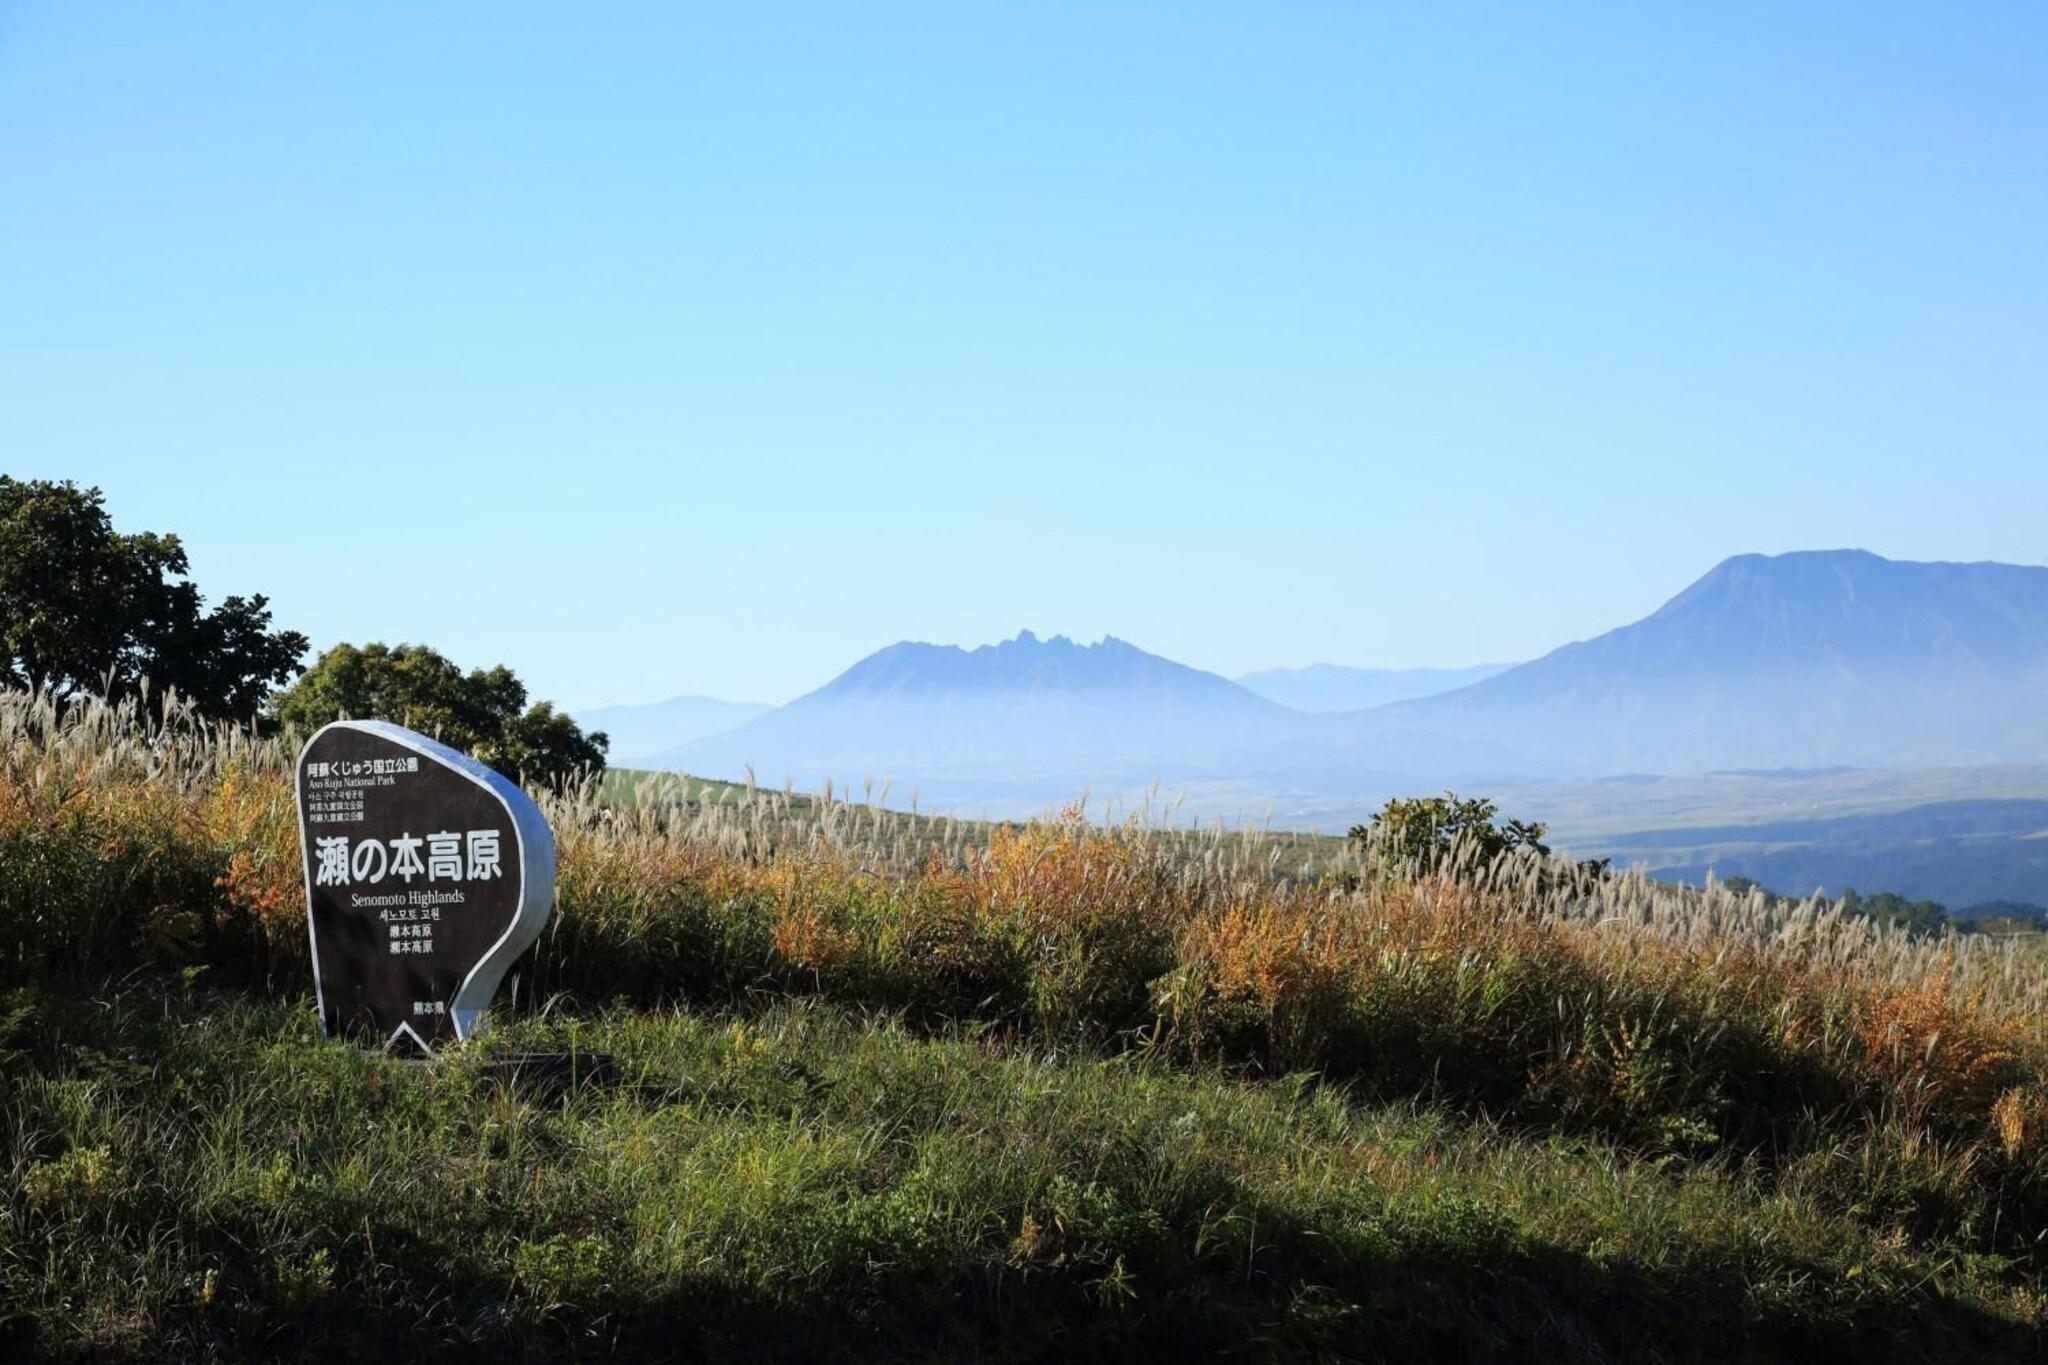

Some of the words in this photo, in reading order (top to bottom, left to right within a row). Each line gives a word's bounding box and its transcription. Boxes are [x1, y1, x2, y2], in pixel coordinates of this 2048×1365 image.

[344, 777, 376, 787] National
[377, 775, 396, 785] Park
[315, 829, 503, 887] 瀬の本高原
[351, 893, 406, 908] Senomoto
[408, 889, 465, 908] Highlands
[420, 907, 442, 921] 고원
